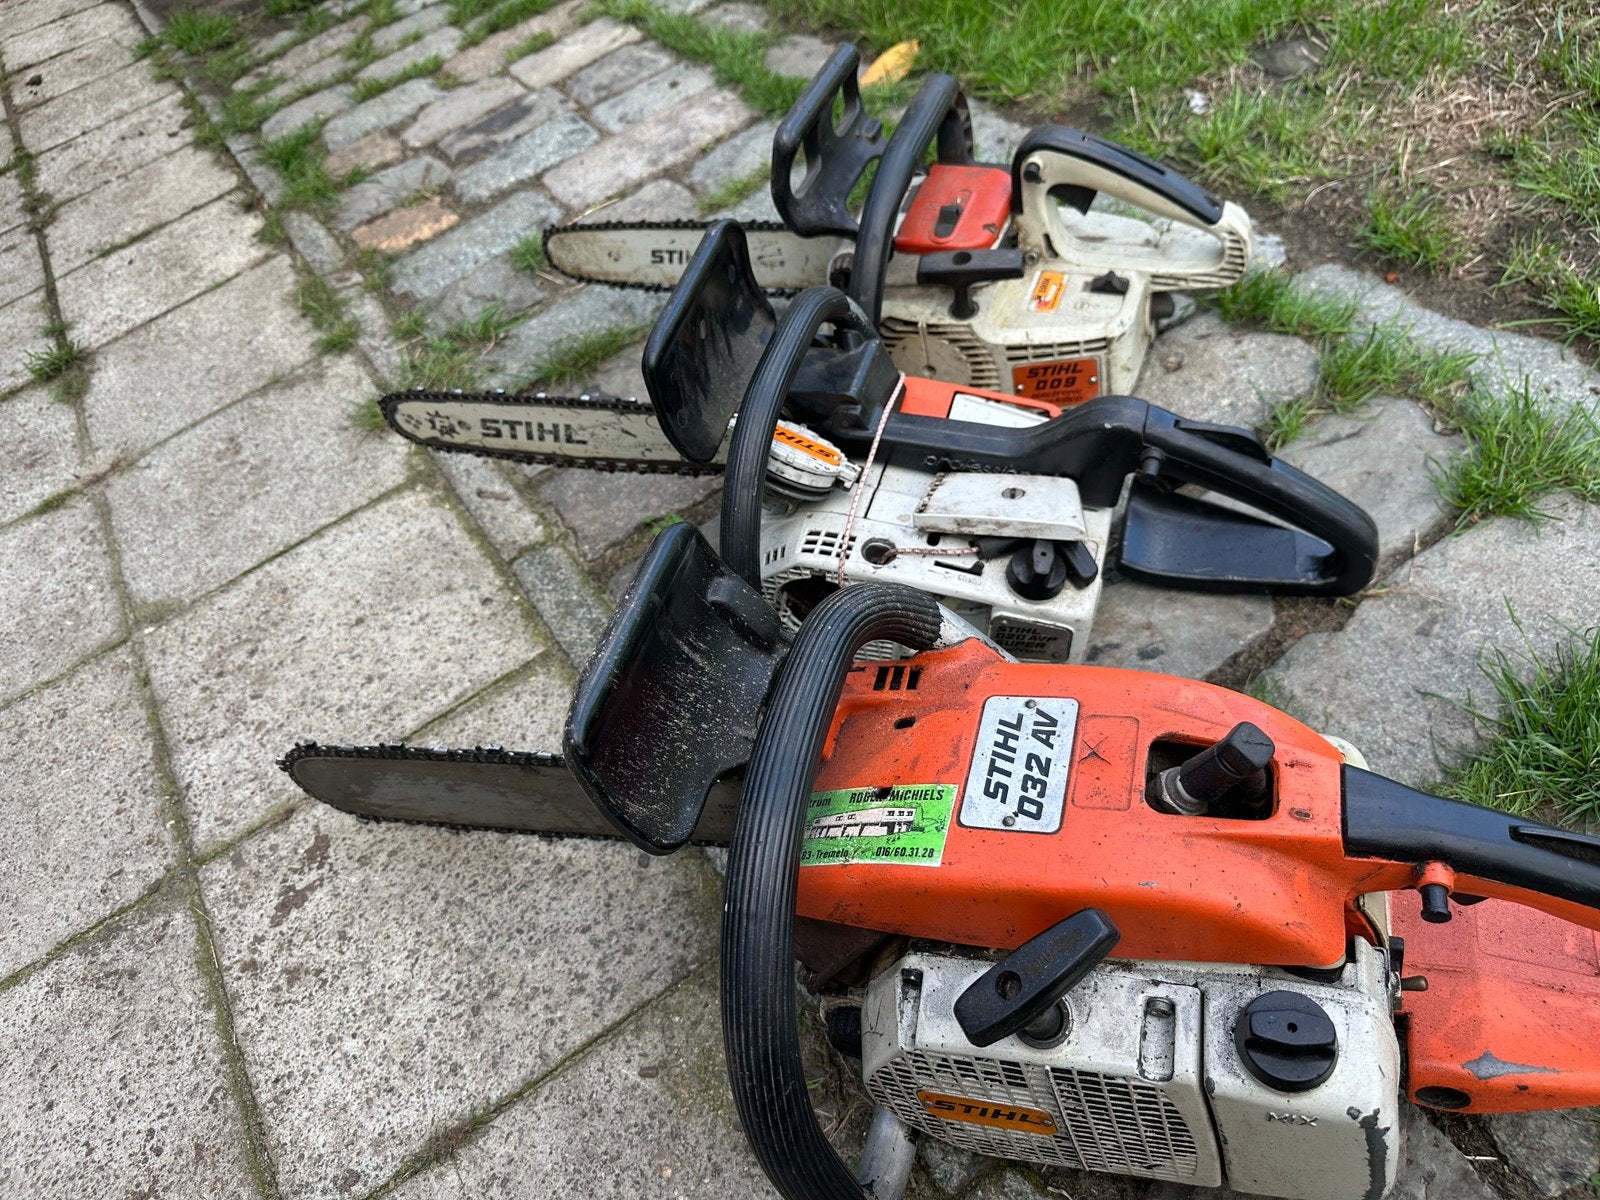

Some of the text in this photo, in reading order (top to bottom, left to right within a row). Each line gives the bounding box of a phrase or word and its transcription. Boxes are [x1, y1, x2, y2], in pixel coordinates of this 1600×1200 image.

[651, 249, 694, 265] STI
[1027, 362, 1083, 379] STIHL
[1035, 376, 1077, 390] 009
[480, 418, 588, 445] STIHL
[775, 430, 835, 458] STIH
[997, 625, 1041, 635] STIHL
[983, 712, 1024, 804] STIHL
[1017, 707, 1059, 821] 032 AV
[876, 846, 935, 858] 016/60.31.28
[934, 1100, 1042, 1126] STIHL
[1267, 1111, 1319, 1127] MIX
